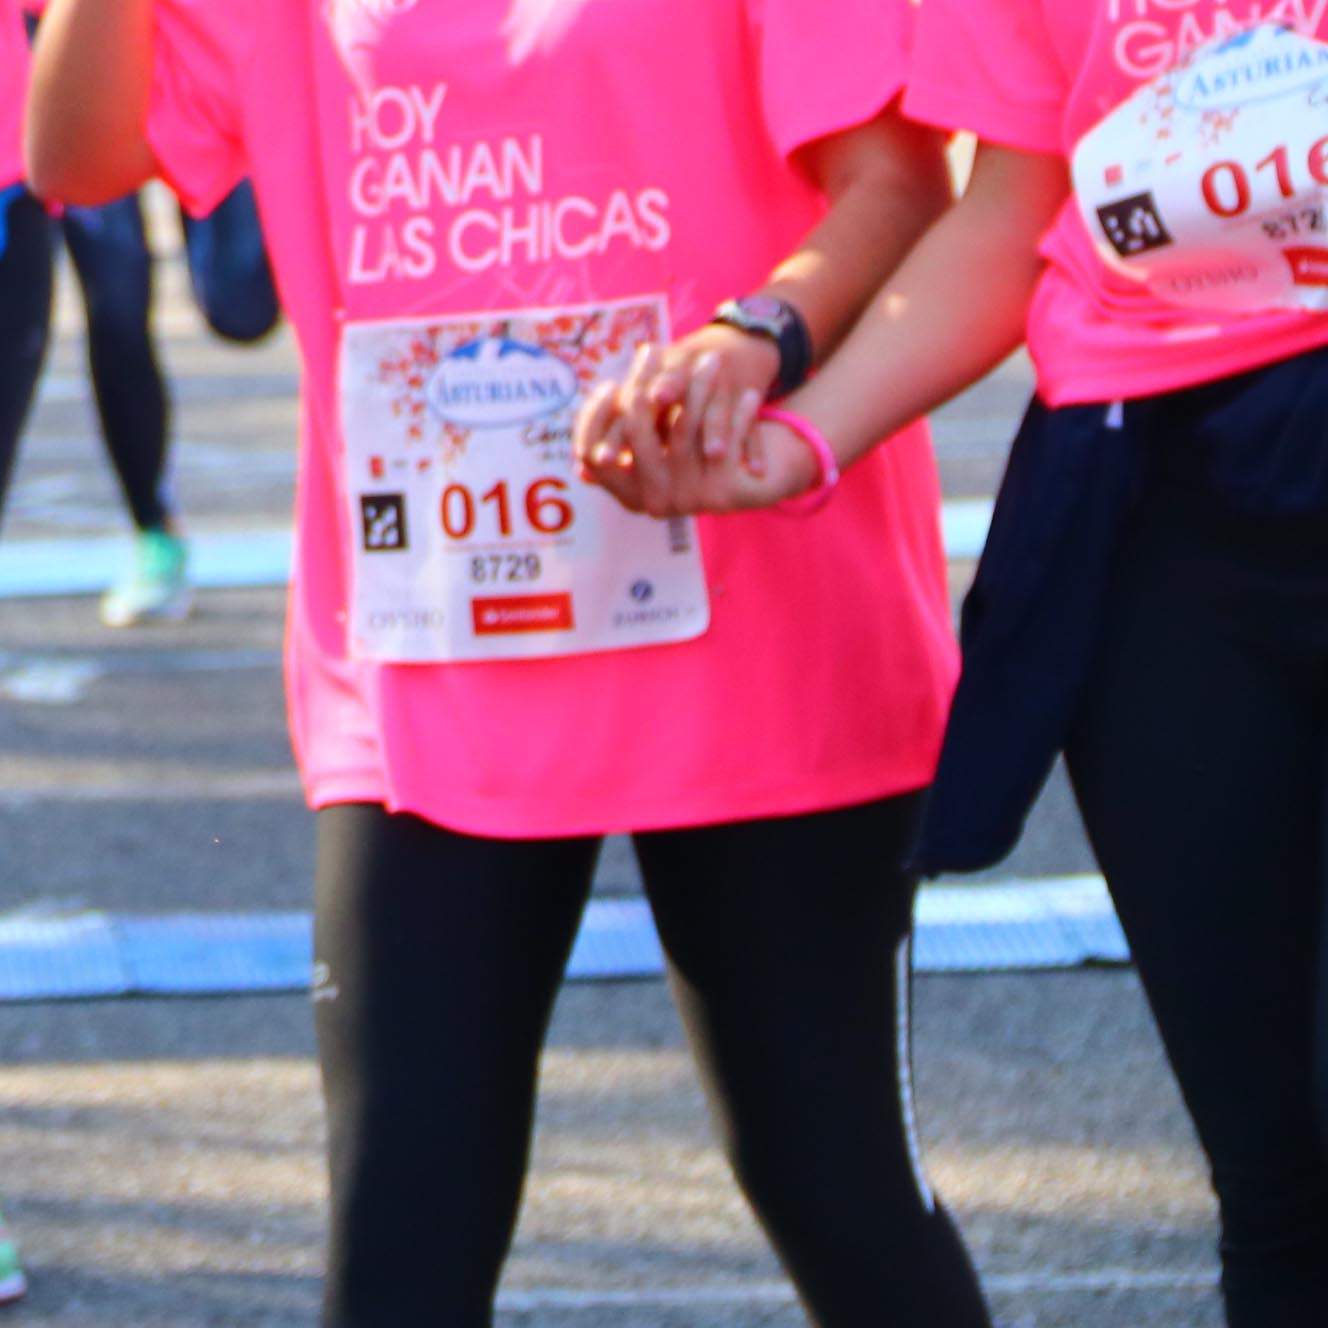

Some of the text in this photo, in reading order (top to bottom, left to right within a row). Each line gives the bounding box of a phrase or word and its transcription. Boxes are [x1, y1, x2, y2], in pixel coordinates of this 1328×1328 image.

[350, 82, 448, 154] HOY
[348, 132, 543, 217] GANAN
[347, 188, 673, 284] LAS CHICAS
[440, 476, 575, 540] 016
[470, 553, 542, 583] 8729
